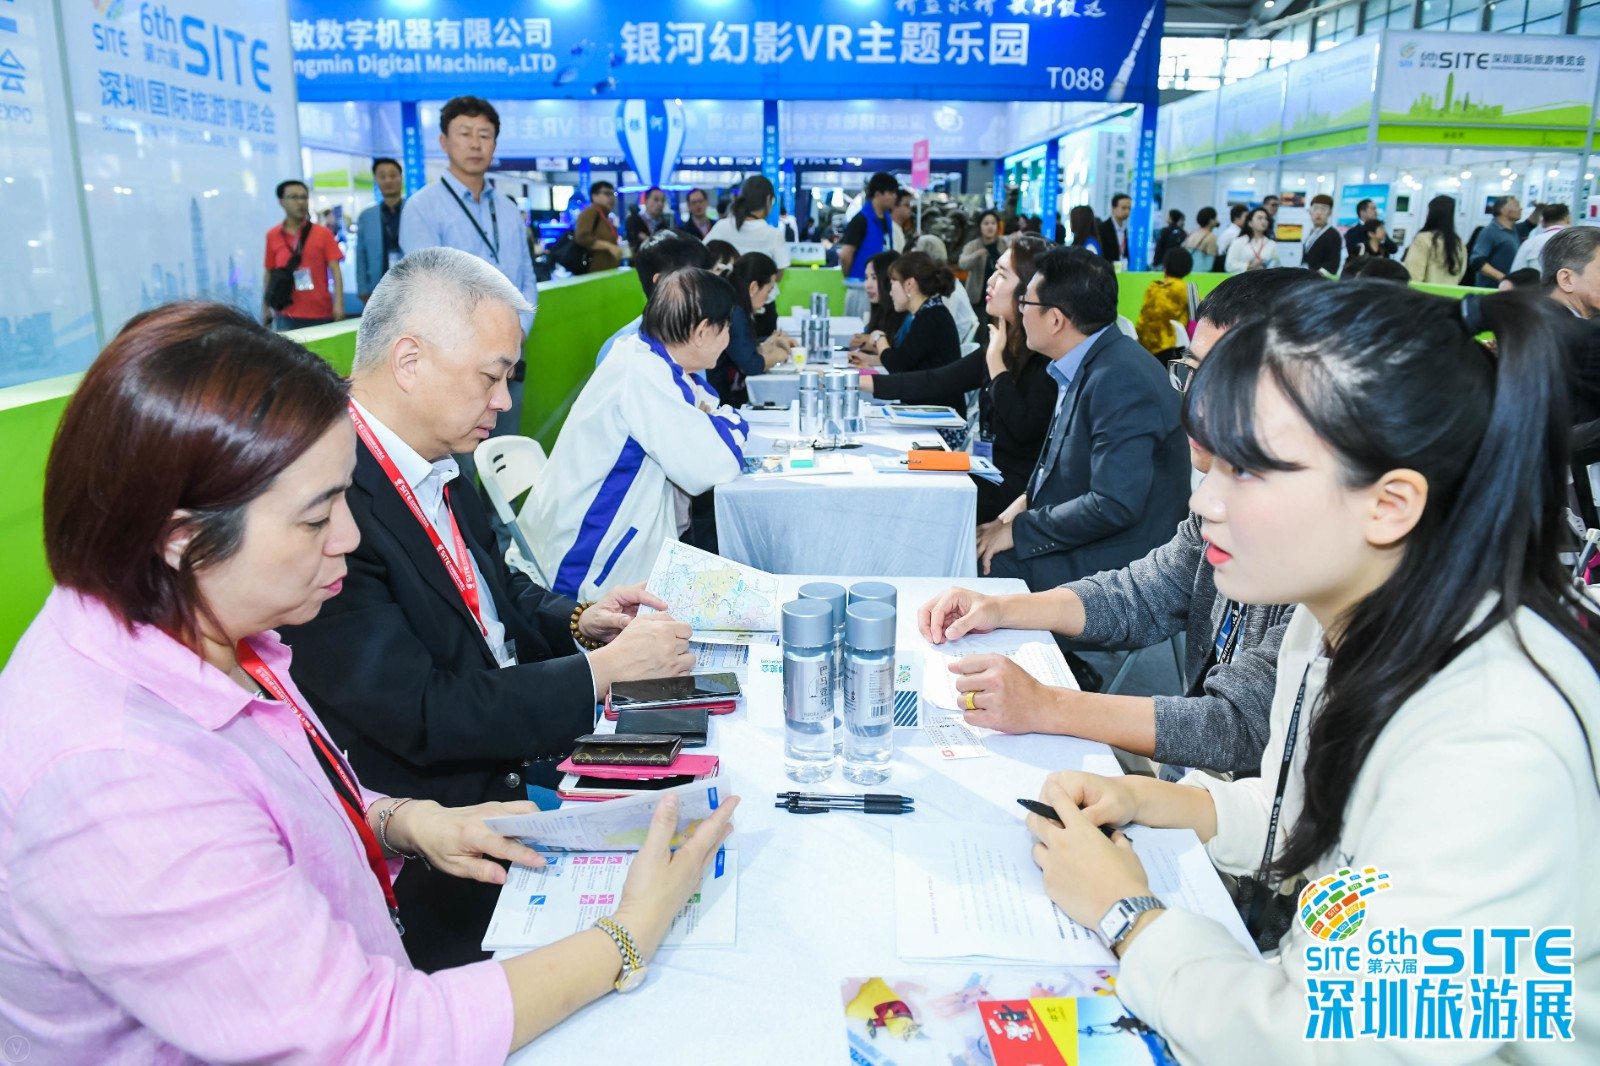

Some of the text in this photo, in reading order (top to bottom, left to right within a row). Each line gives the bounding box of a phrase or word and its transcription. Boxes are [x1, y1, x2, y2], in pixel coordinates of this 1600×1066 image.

[92, 22, 129, 57] SITE
[140, 2, 272, 94] 6th SITE
[620, 20, 1031, 67] 银河幻影VR主题乐园
[357, 53, 423, 77] Digital
[1438, 52, 1490, 70] SITE
[1491, 52, 1587, 67] 深圳国际旅游博览会
[1047, 66, 1105, 91] T088
[98, 69, 276, 134] 深圳国际旅游博览会
[350, 412, 364, 430] SITE
[400, 484, 413, 501] SITE
[440, 550, 452, 566] SITE
